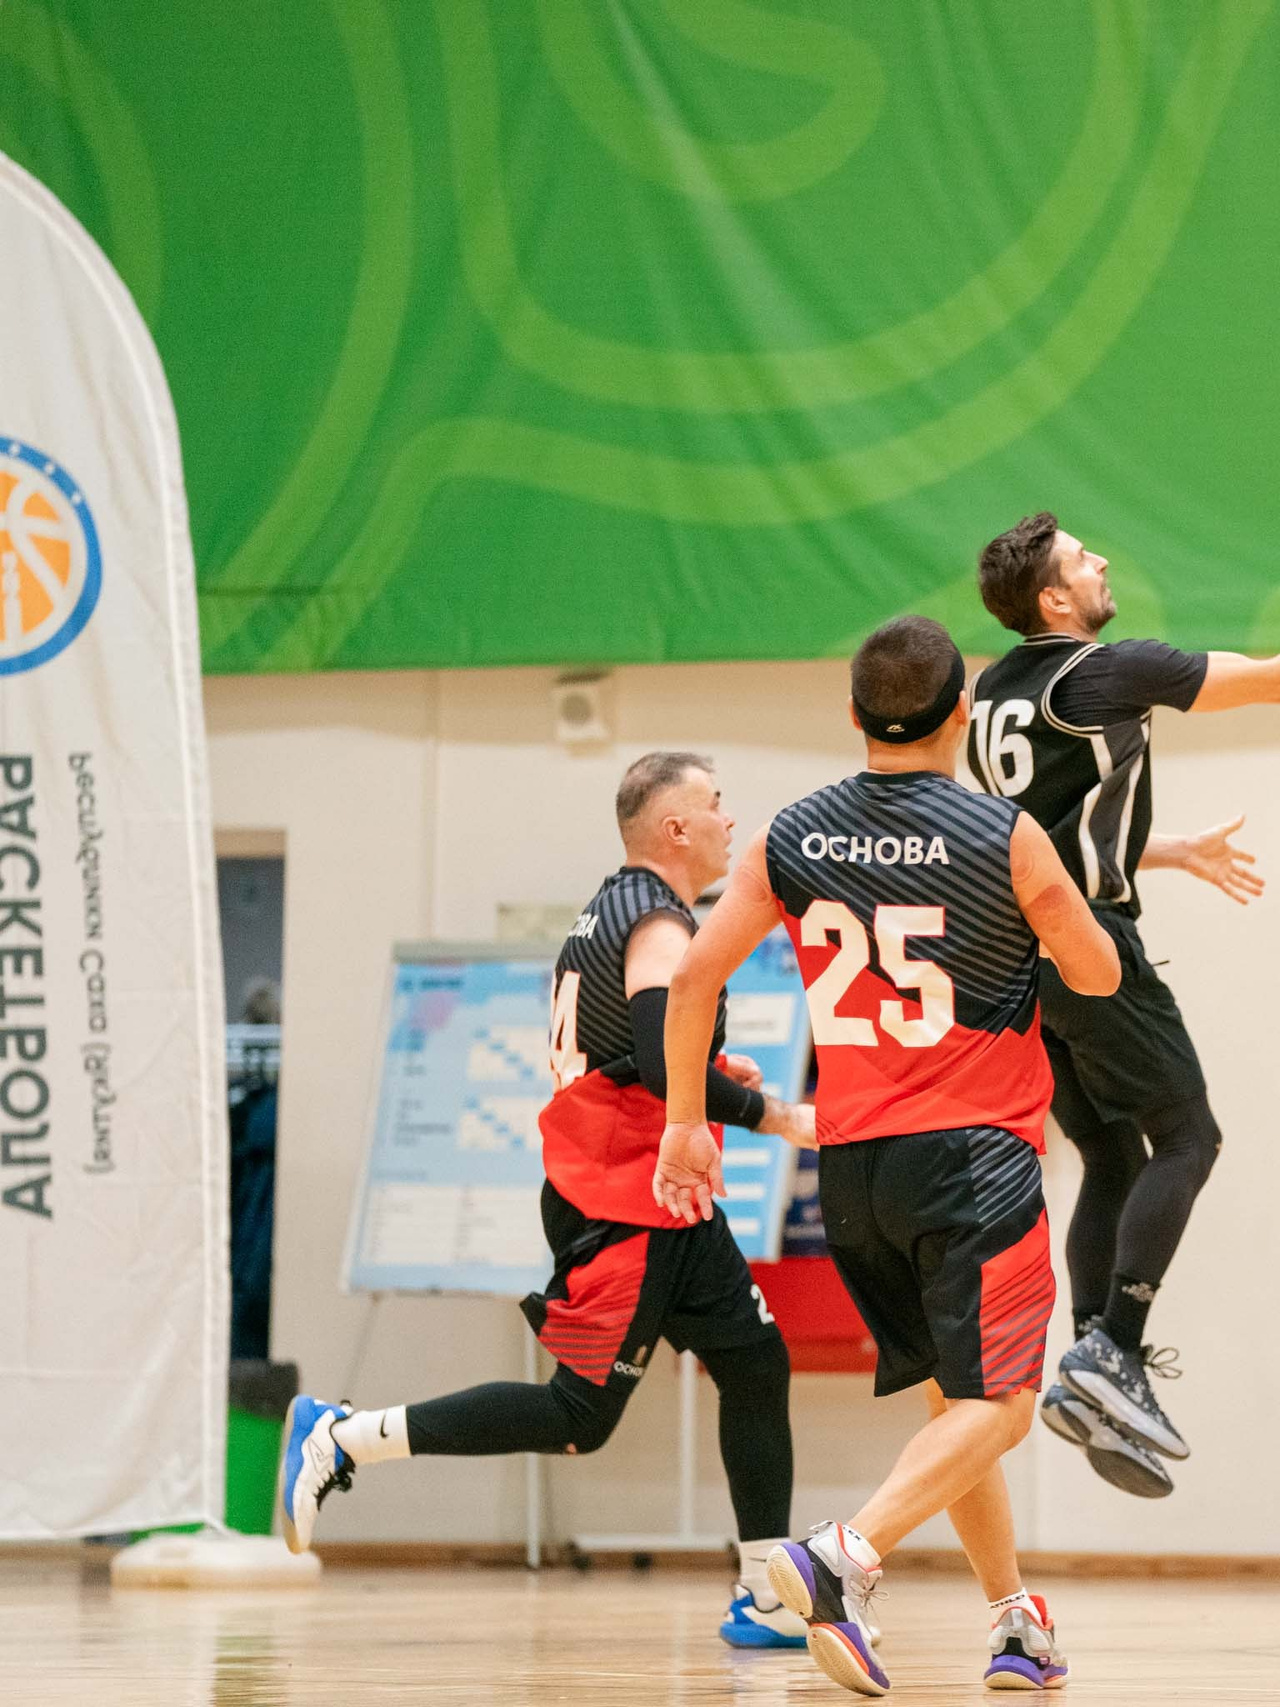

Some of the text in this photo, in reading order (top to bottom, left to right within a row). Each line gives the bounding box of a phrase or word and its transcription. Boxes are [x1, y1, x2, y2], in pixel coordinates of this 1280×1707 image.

[969, 699, 1036, 797] 16
[801, 832, 950, 865] ОСНОВА
[800, 899, 956, 1048] 25
